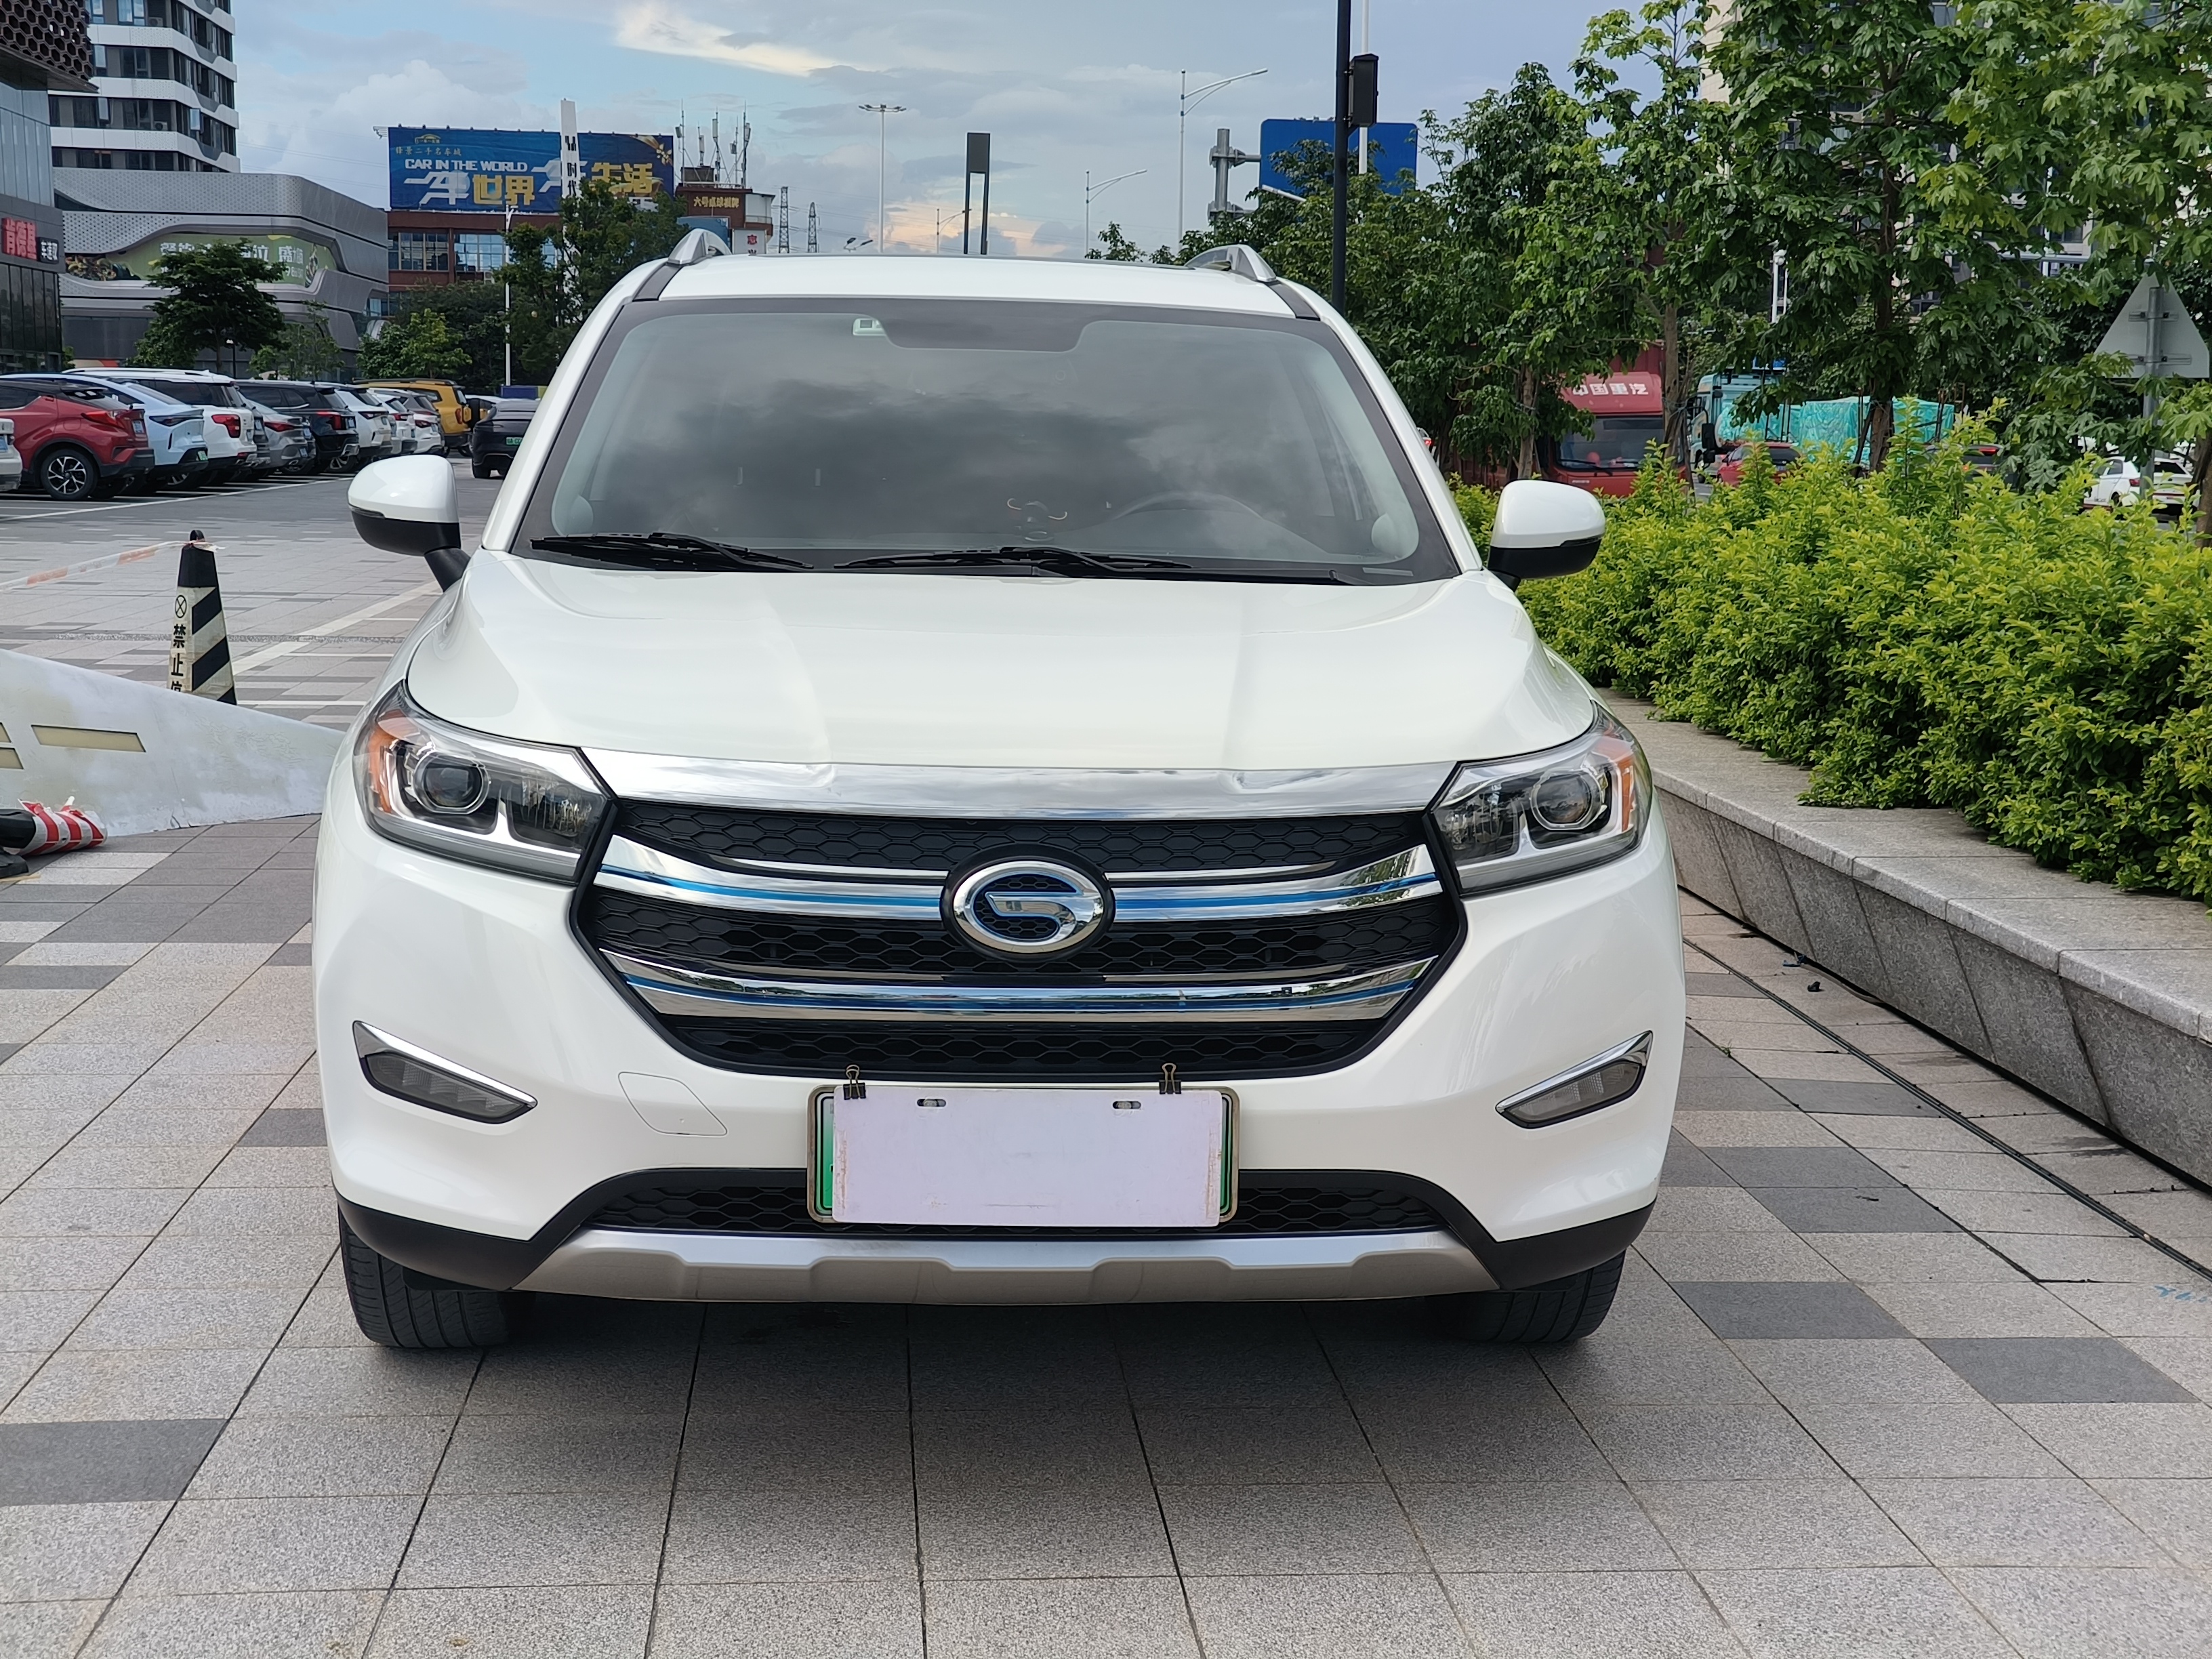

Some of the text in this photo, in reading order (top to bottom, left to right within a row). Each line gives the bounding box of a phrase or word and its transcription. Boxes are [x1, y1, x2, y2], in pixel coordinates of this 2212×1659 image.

[405, 159, 529, 172] CAR IN THE WORLD
[4, 218, 37, 260] 肯德基
[1572, 383, 1649, 396] 中国重汽
